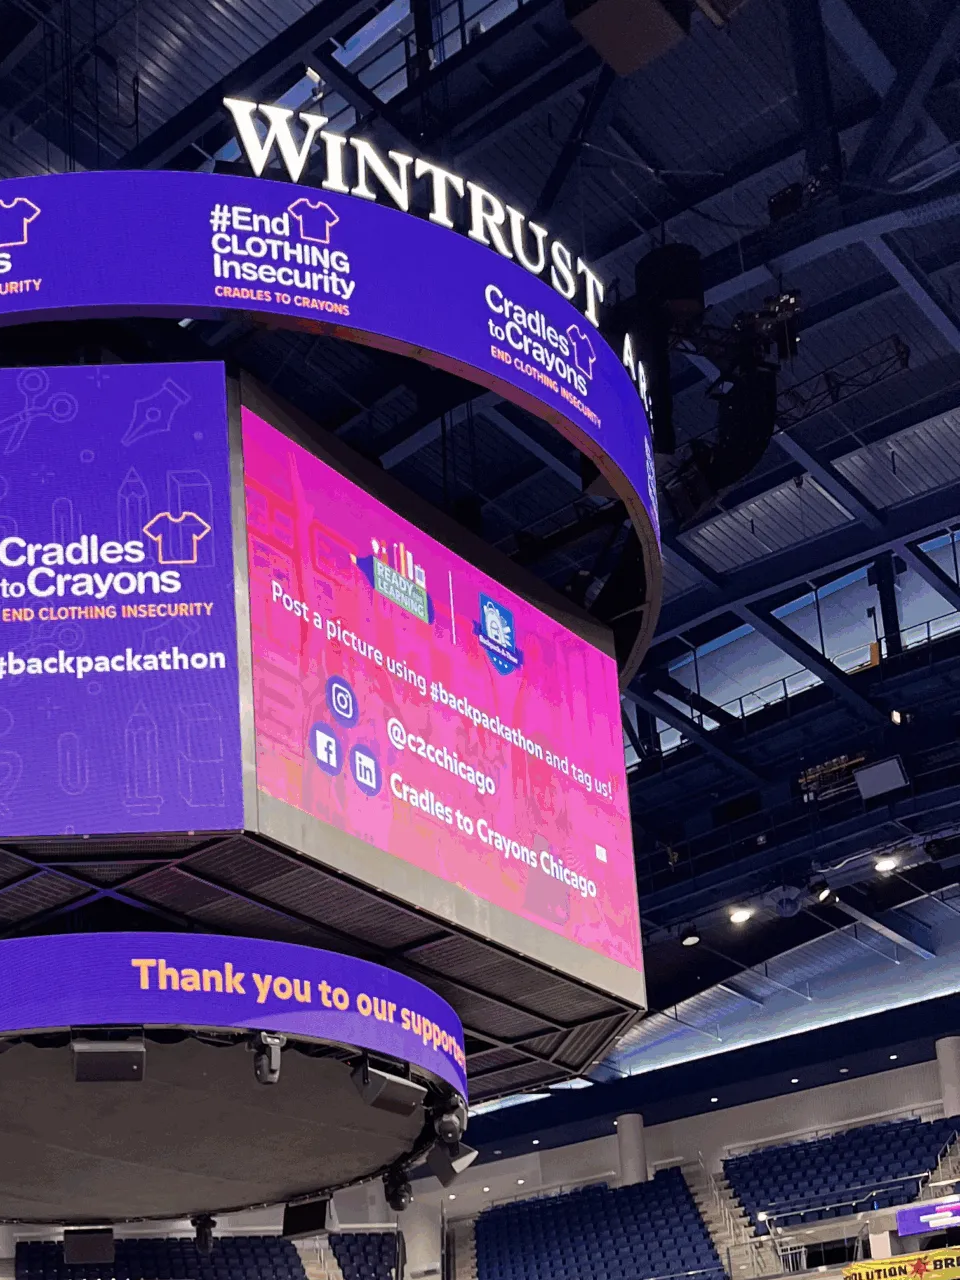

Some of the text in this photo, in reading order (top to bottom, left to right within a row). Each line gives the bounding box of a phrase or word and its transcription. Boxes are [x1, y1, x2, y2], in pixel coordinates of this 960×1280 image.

[209, 203, 290, 236] #End
[223, 97, 605, 328] WINTRUST
[210, 232, 351, 275] CLOTHING
[212, 253, 356, 300] Insecurity
[214, 285, 351, 317] CRADLES TO CRAYONS
[485, 284, 570, 356] Cradles
[491, 345, 602, 429] END CLOTHING INSECURITY
[376, 561, 414, 596] READY
[378, 577, 425, 617] LEARNING
[1, 602, 214, 622] END CLOTHING INSECURITY
[271, 580, 613, 800] Post a picture using #backpackathon and tag us!
[386, 716, 496, 796] @c2cchicago
[390, 772, 597, 898] Cradles to Crayons Chicago
[131, 957, 396, 1024] Thank you to our
